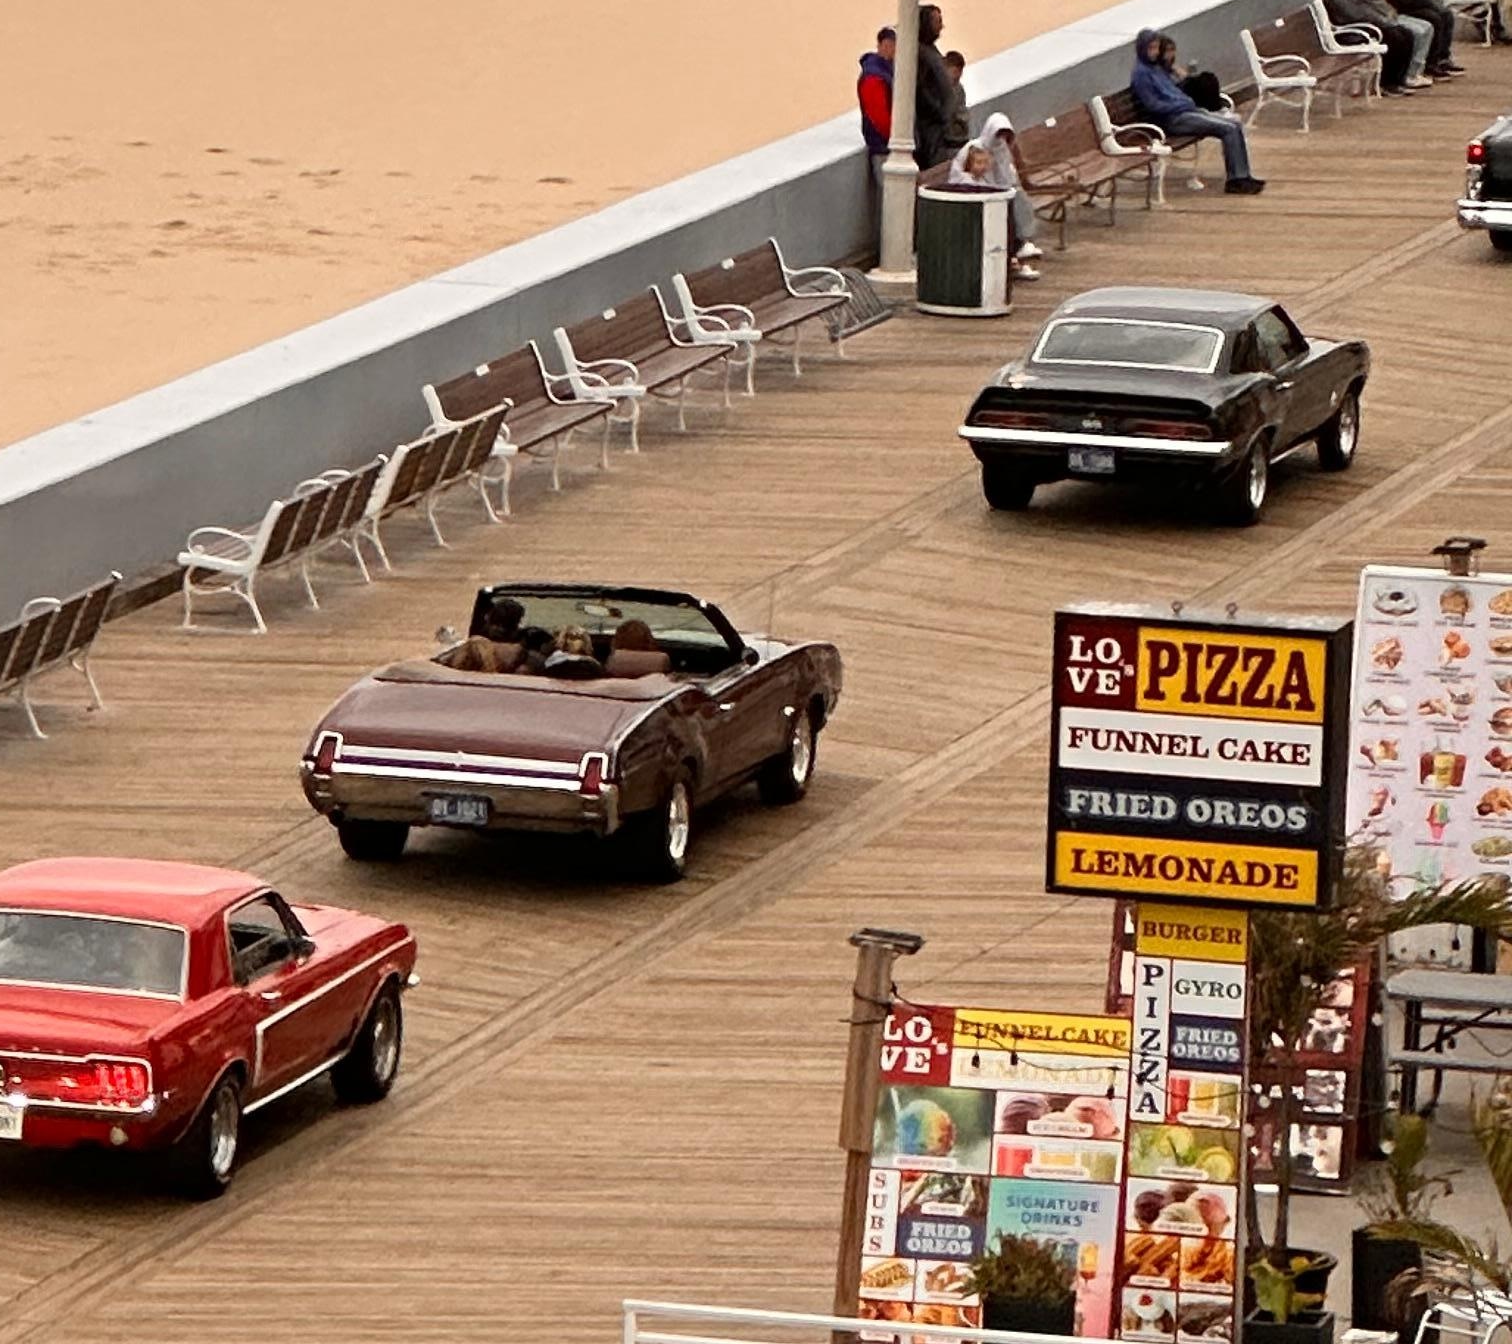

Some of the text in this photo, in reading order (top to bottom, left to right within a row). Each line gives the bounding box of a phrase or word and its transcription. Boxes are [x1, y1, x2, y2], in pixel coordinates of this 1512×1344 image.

[1069, 635, 1122, 664] LO
[1143, 639, 1316, 712] PIZZA
[1068, 726, 1311, 765] FUNNEL CAKE
[1067, 788, 1308, 830] FRIED OREOS
[1071, 848, 1299, 890] LEMONADE
[1142, 920, 1242, 945] BURGER
[1174, 978, 1242, 1000] GYRO
[1062, 1026, 1127, 1047] CAKE
[1174, 1025, 1238, 1044] FRIED
[1172, 1042, 1240, 1063] OREOS
[1005, 1194, 1101, 1214] SIGNATURE
[1020, 1212, 1084, 1227] DRINKS
[909, 1221, 973, 1240] FRIED
[906, 1237, 974, 1255] OREOS
